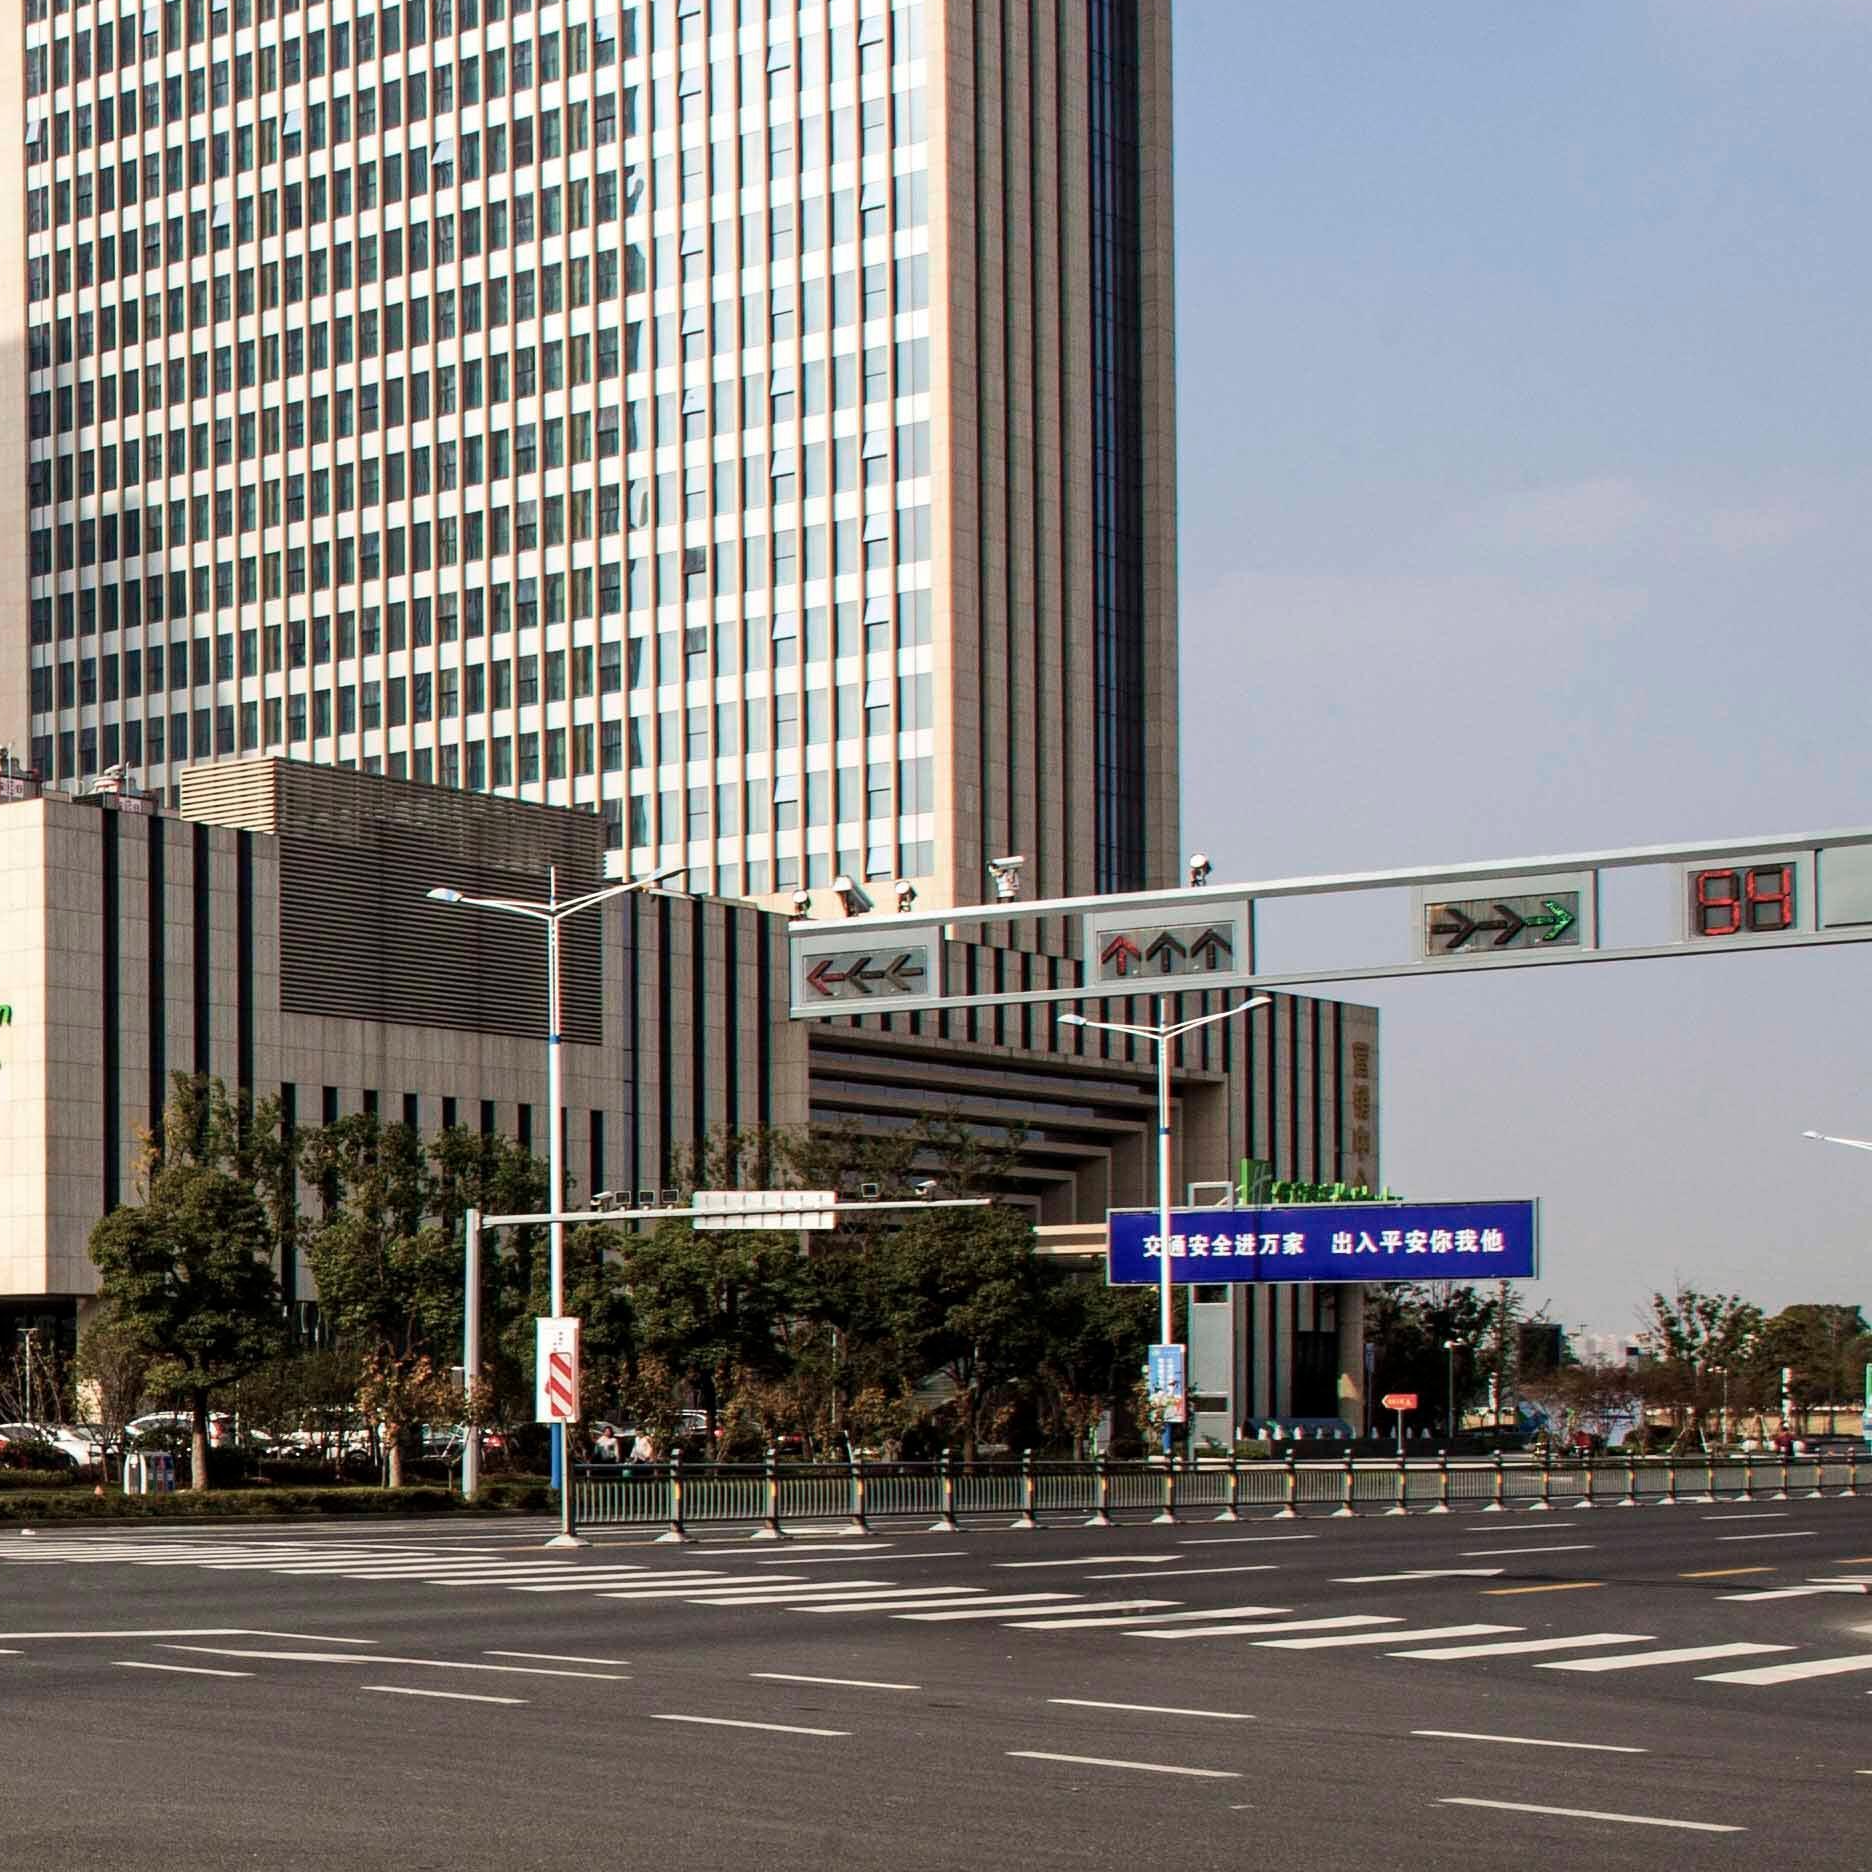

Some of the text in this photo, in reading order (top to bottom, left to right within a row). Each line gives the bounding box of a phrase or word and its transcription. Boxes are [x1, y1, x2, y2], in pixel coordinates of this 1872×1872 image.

[1142, 1228, 1504, 1257] 交通安全进万家 出入平安你我他
